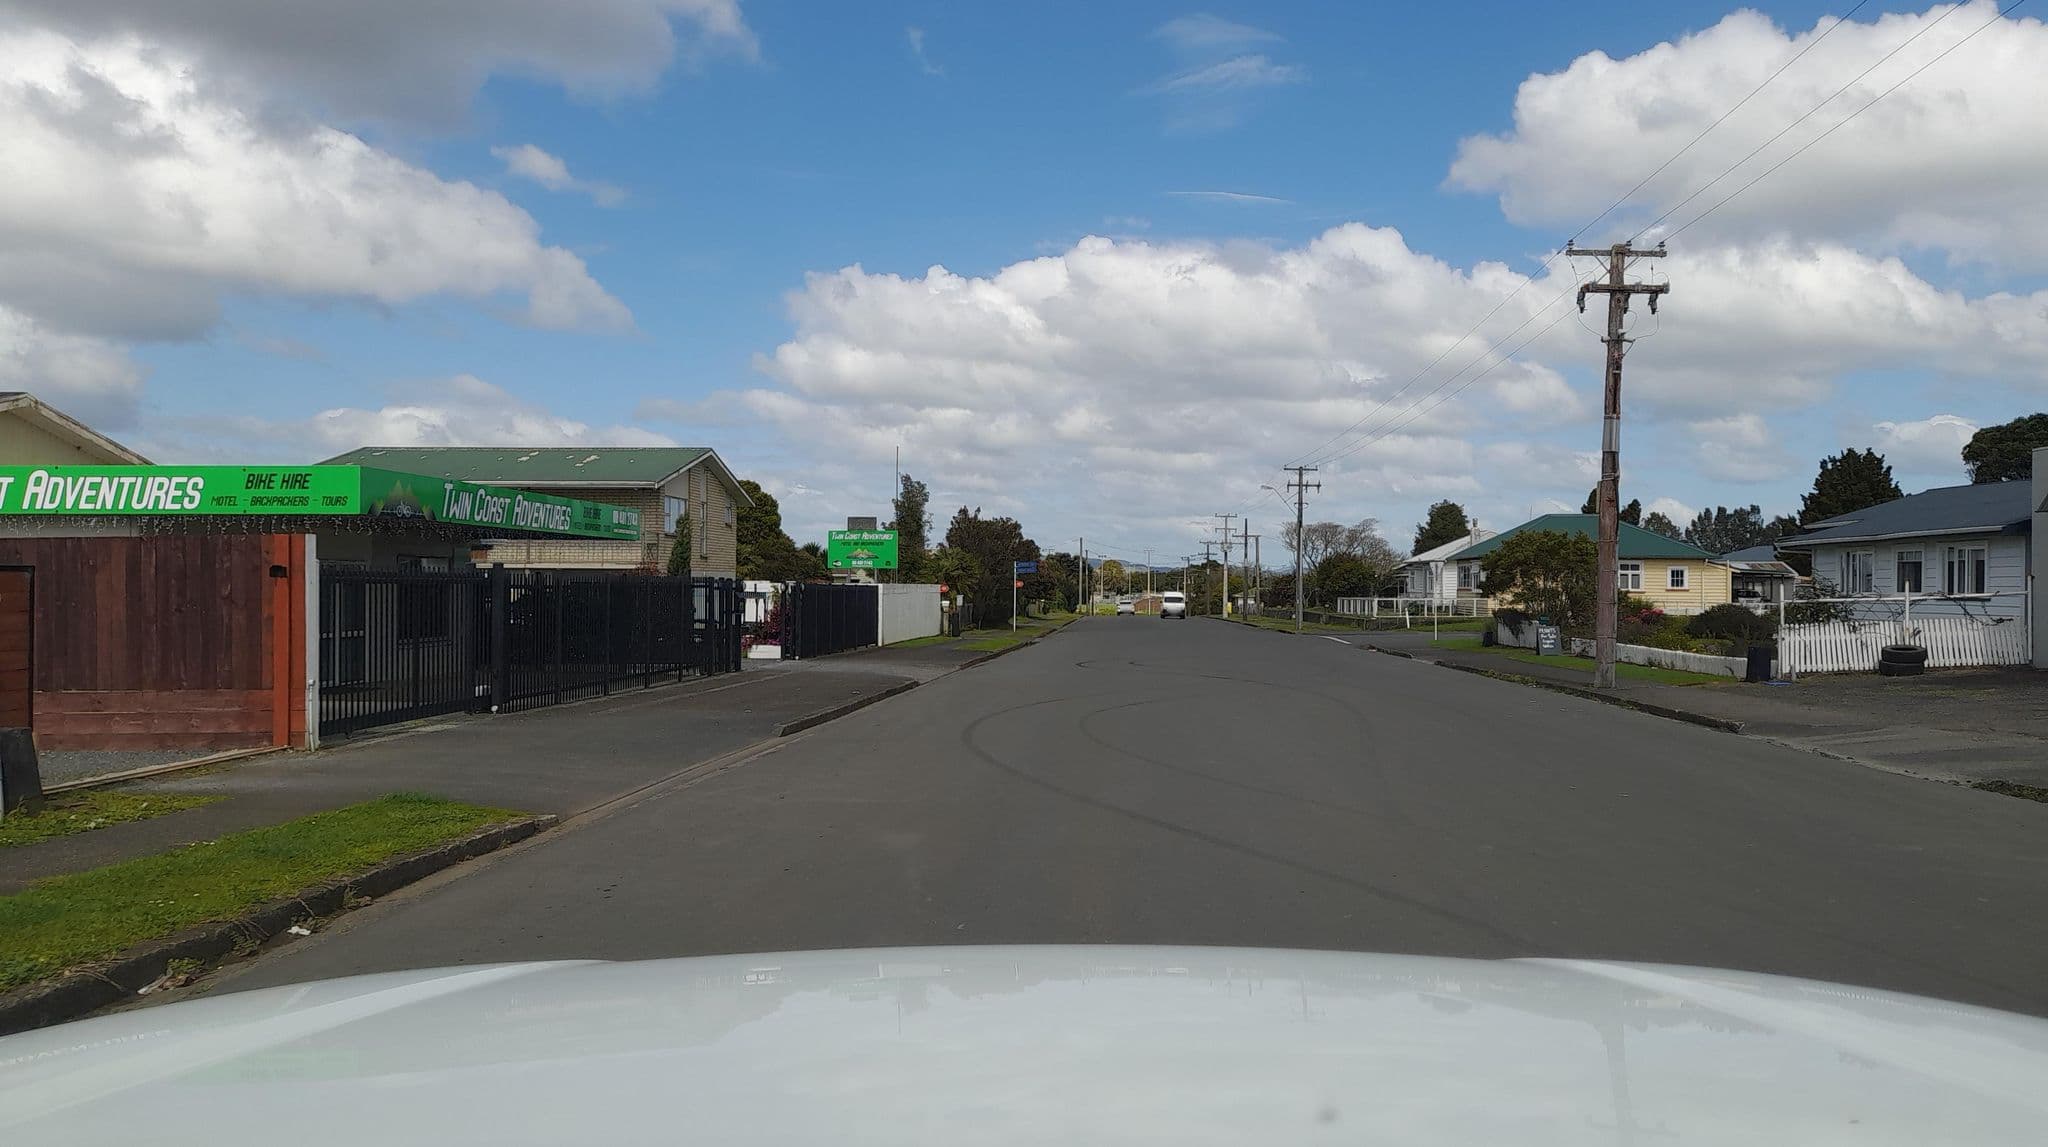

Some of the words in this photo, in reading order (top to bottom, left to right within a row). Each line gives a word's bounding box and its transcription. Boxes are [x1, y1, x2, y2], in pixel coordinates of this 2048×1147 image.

[22, 469, 204, 510] ADVENTURES
[245, 473, 277, 489] BIKE
[280, 473, 312, 489] HIRE
[210, 496, 238, 506] MOTEL
[250, 496, 309, 506] BACKPACKERS
[321, 496, 348, 506] TOURS
[442, 483, 473, 520] TWIN
[474, 488, 511, 524] COAST
[512, 494, 571, 530] ADVENTURES
